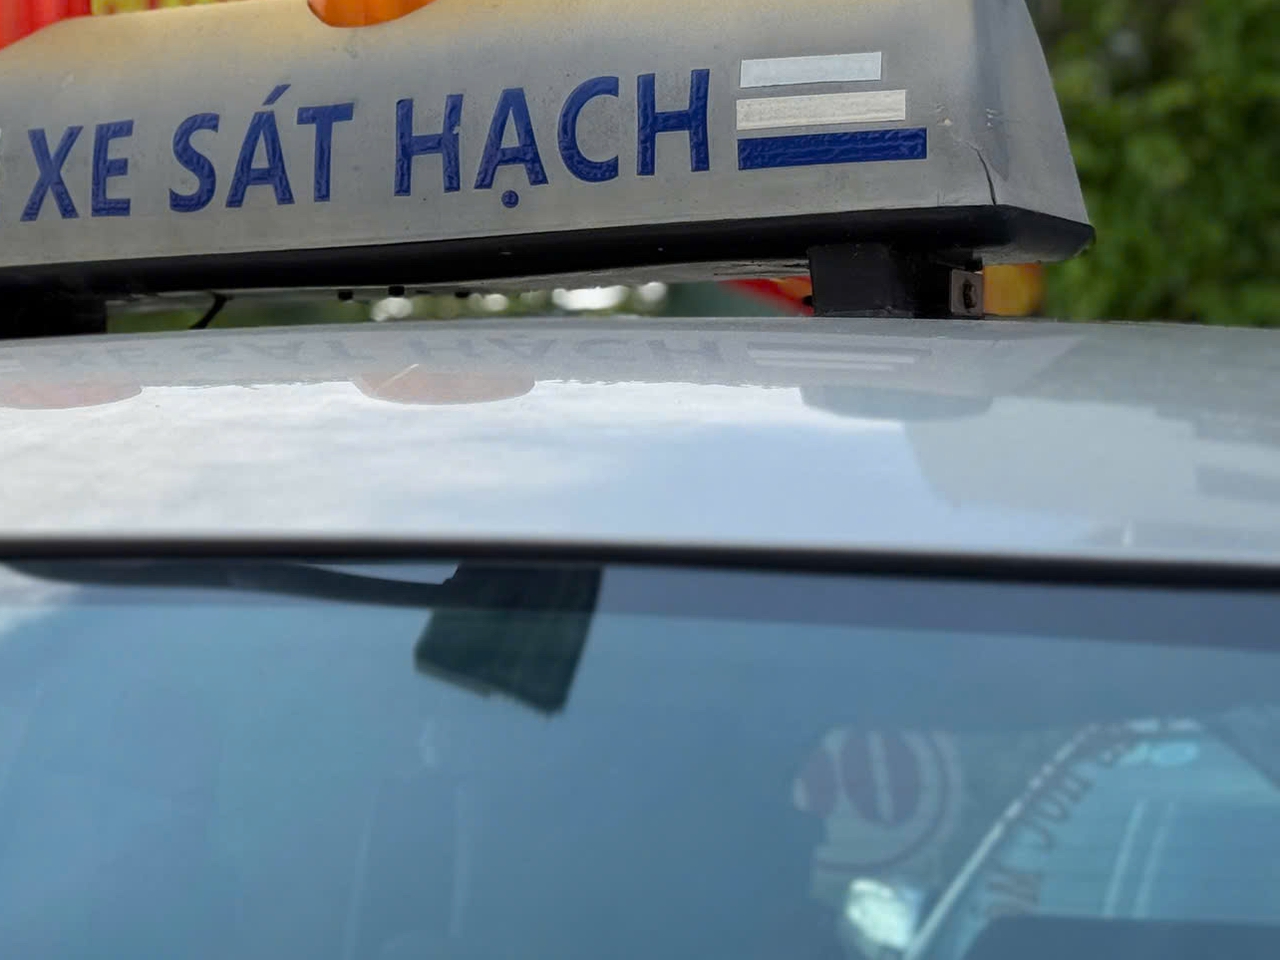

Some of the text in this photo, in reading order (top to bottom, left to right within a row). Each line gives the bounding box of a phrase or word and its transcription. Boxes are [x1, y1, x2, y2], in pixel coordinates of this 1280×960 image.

[20, 68, 711, 222] XE SÁT HẠCH
